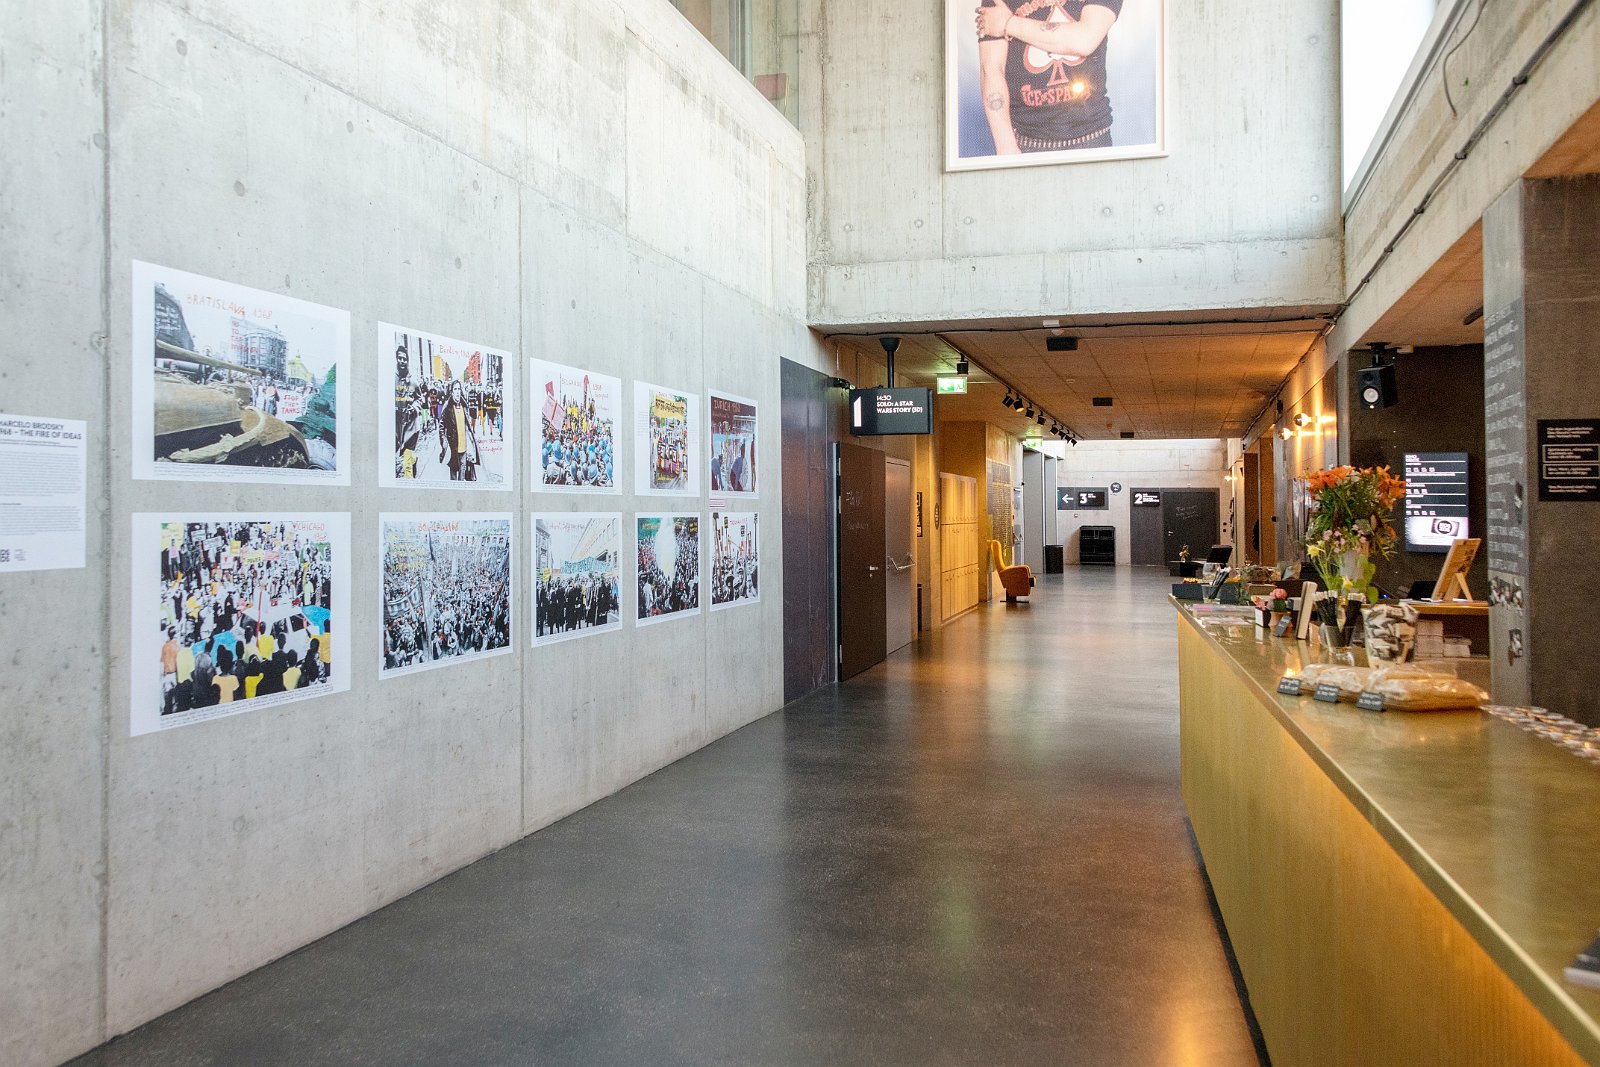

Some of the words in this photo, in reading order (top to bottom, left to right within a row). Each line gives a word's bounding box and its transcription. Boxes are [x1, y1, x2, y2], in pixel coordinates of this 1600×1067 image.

[854, 396, 862, 427] 1
[33, 422, 64, 430] BRODSKY
[62, 432, 82, 440] IDEAS
[1080, 493, 1088, 504] 3
[1134, 493, 1143, 504] 2
